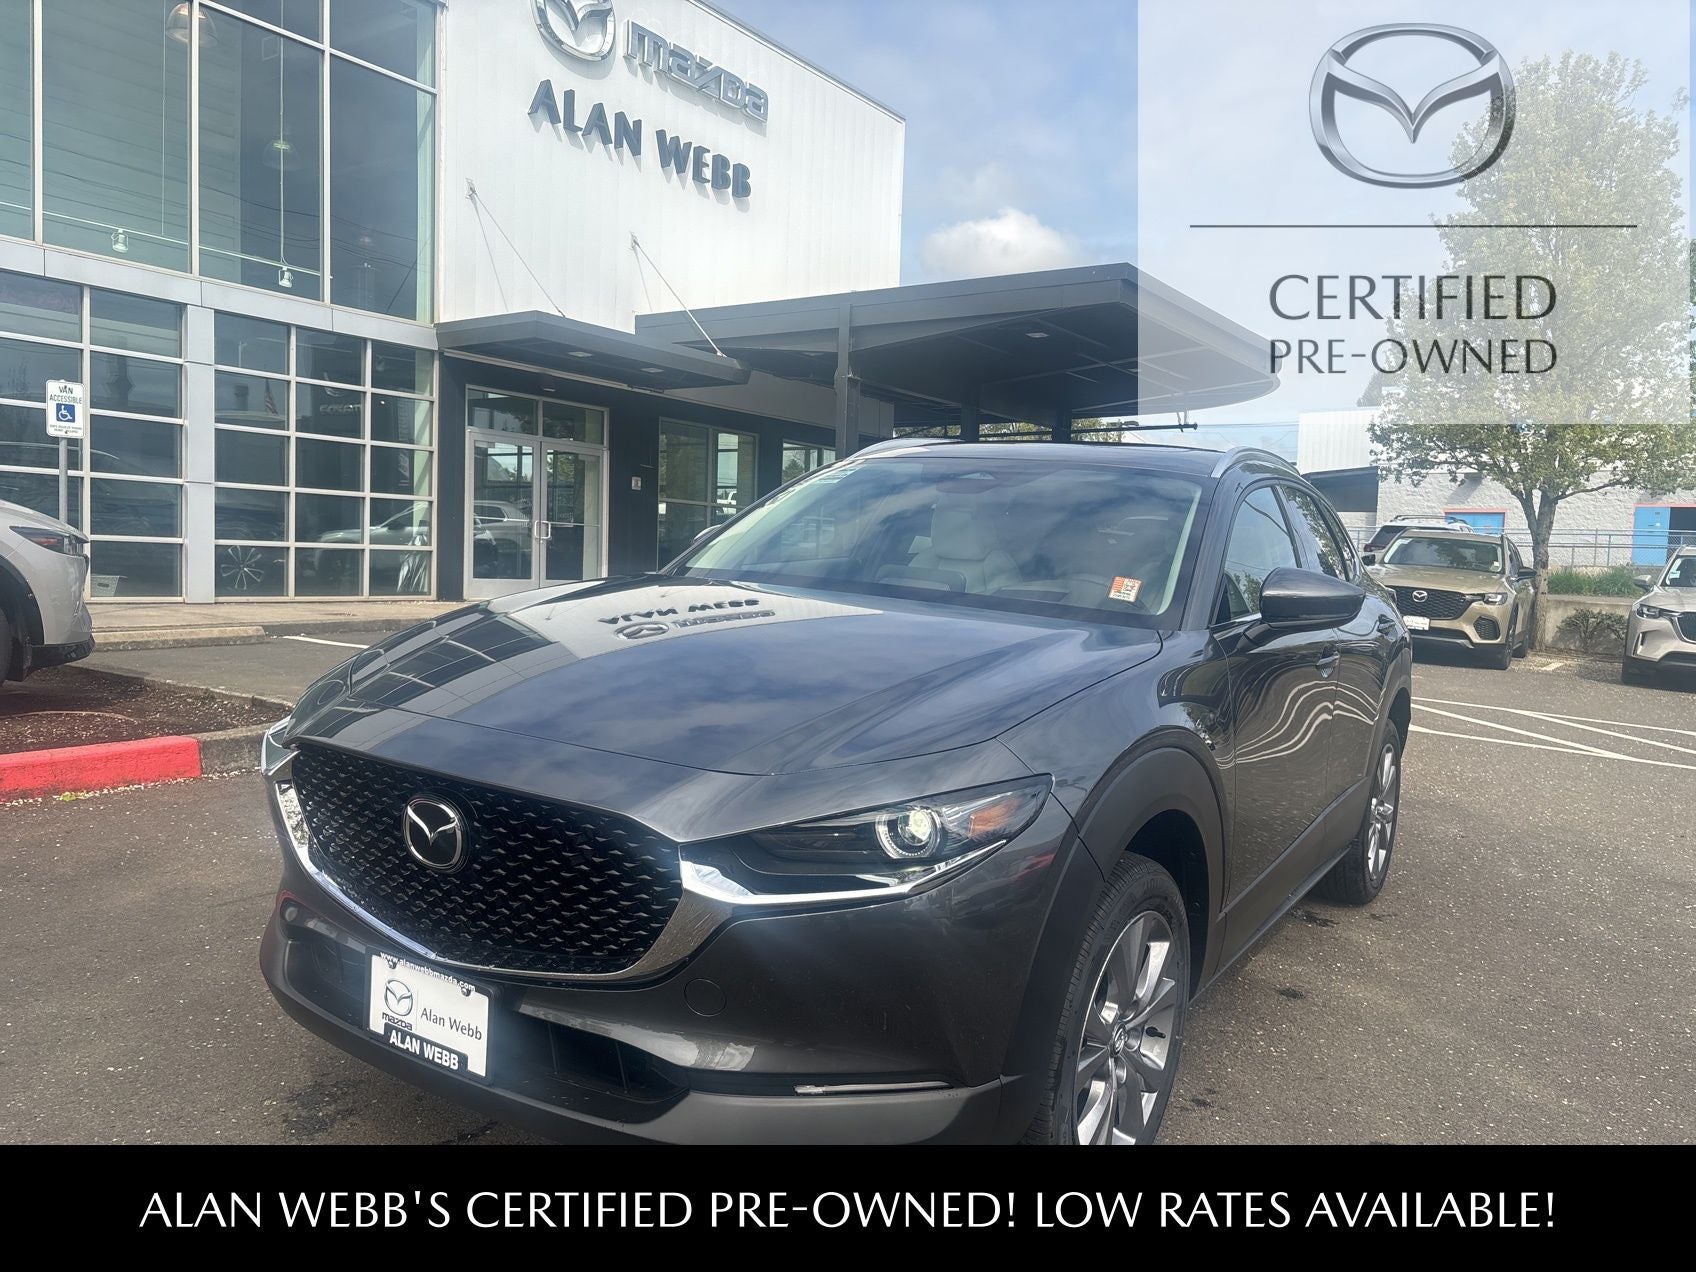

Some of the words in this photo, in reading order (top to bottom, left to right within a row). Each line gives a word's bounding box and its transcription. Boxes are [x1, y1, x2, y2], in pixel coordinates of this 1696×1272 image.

[623, 19, 769, 124] mazda
[527, 78, 643, 157] ALAN
[655, 128, 752, 199] WEBB
[49, 394, 83, 404] ACCESSIBLE
[59, 385, 74, 394] VAN
[380, 951, 476, 993] www.alanwebbmazda.com
[381, 1011, 413, 1031] mazda
[420, 1007, 446, 1028] Alan
[448, 1016, 482, 1041] Webb
[389, 1029, 420, 1055] ALAN
[423, 1041, 459, 1070] WEBB
